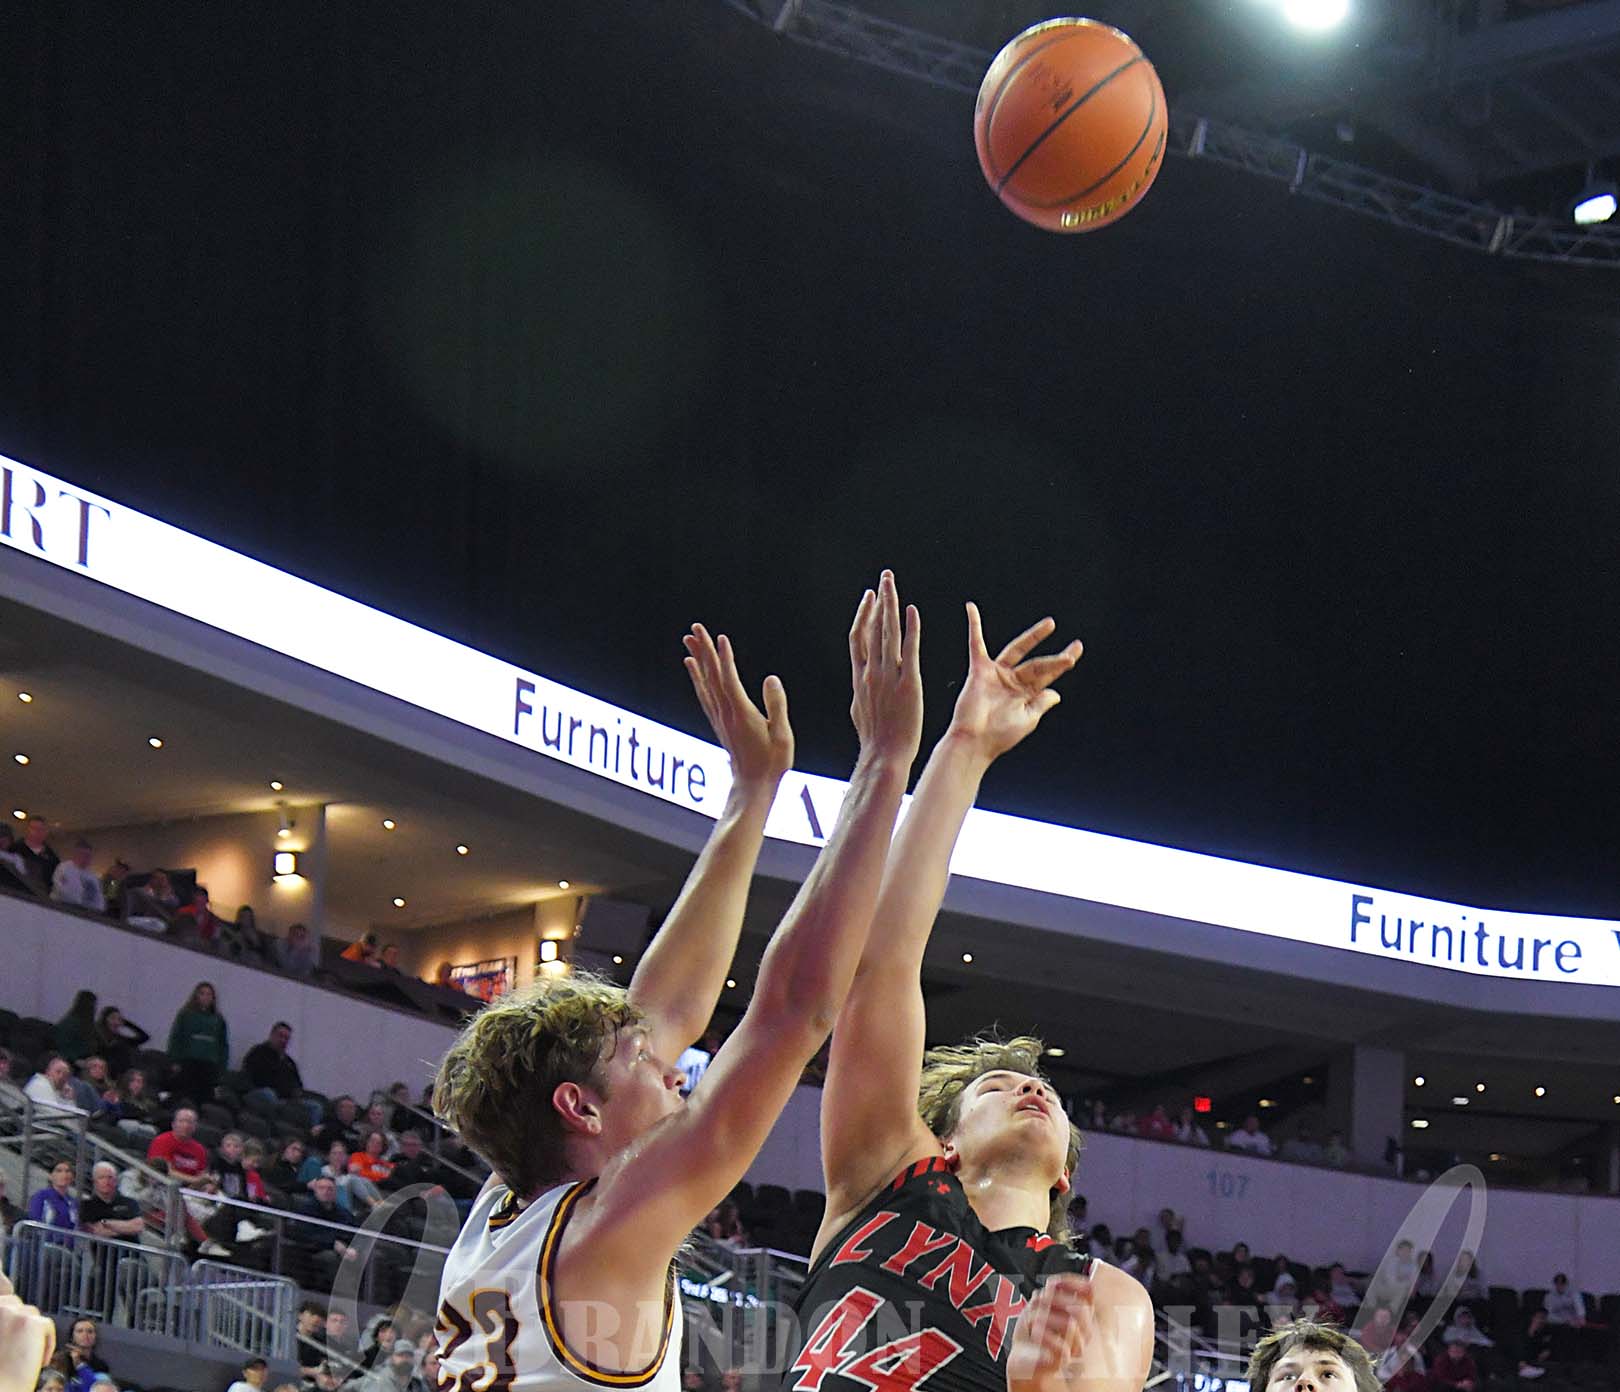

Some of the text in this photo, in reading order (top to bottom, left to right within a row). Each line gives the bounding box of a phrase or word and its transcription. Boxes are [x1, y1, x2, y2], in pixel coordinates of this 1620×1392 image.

[0, 466, 111, 568] RT
[514, 677, 707, 803] Furniture
[1350, 892, 1583, 973] Furniture
[1206, 1170, 1250, 1198] 107
[828, 1211, 1027, 1362] LYNX
